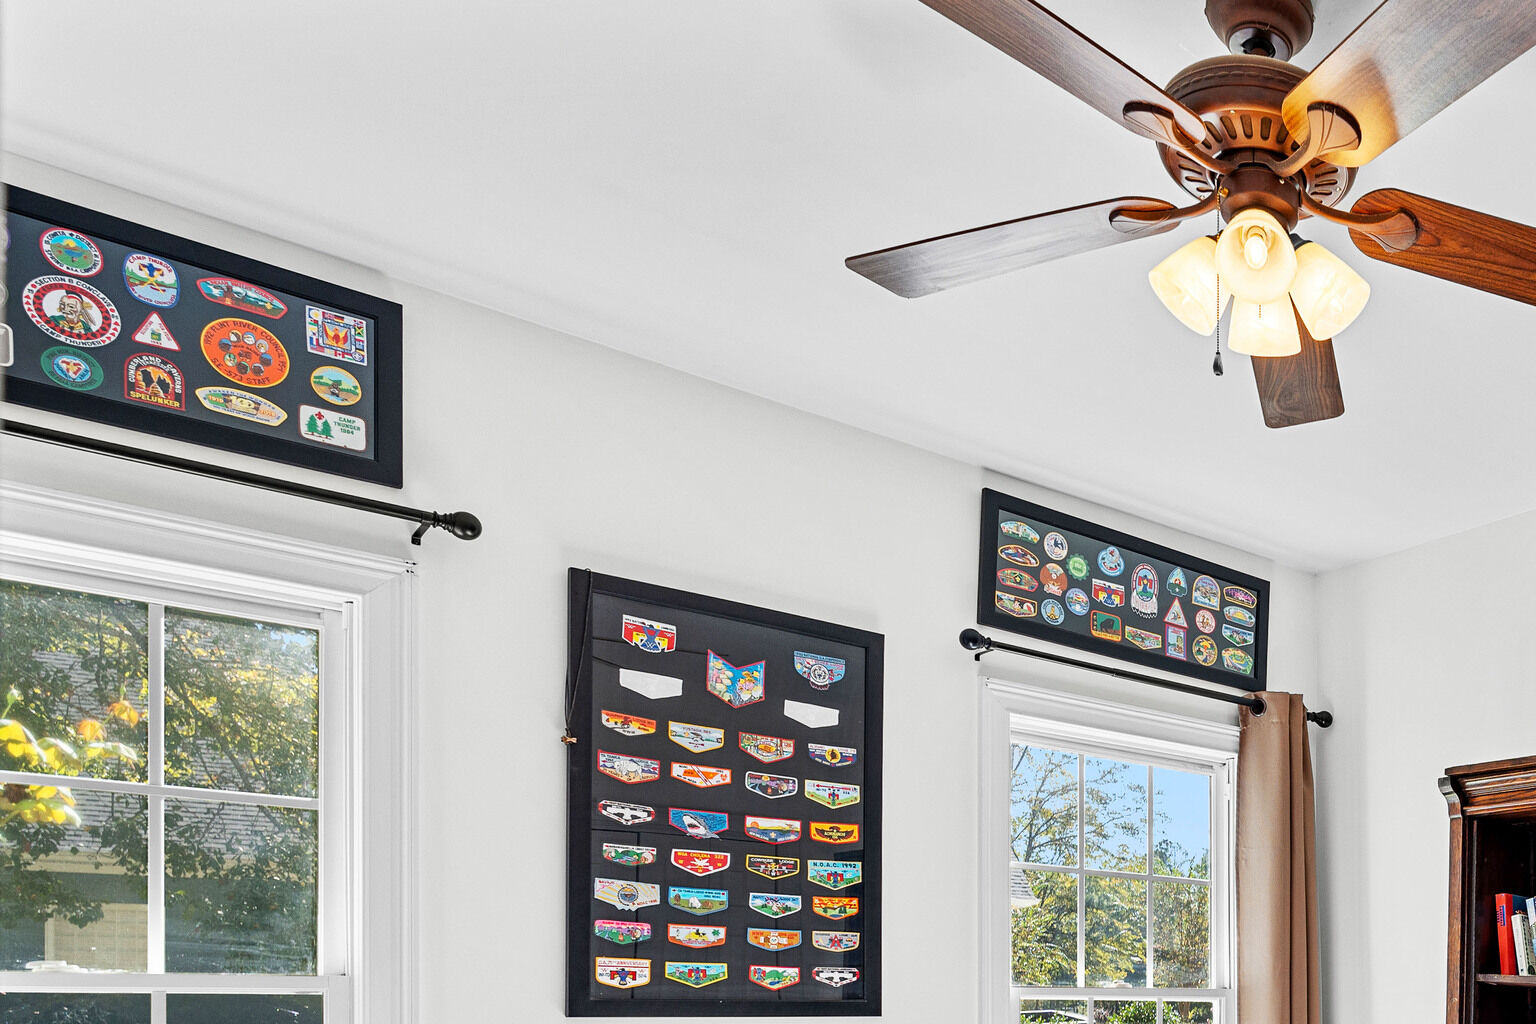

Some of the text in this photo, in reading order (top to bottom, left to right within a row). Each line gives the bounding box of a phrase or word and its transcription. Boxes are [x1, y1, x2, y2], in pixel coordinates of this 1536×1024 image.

[35, 276, 66, 286] SECTION
[76, 280, 112, 307] CONCLAVE
[128, 355, 162, 383] CUMBERLAND
[129, 390, 181, 408] SPELUNKER
